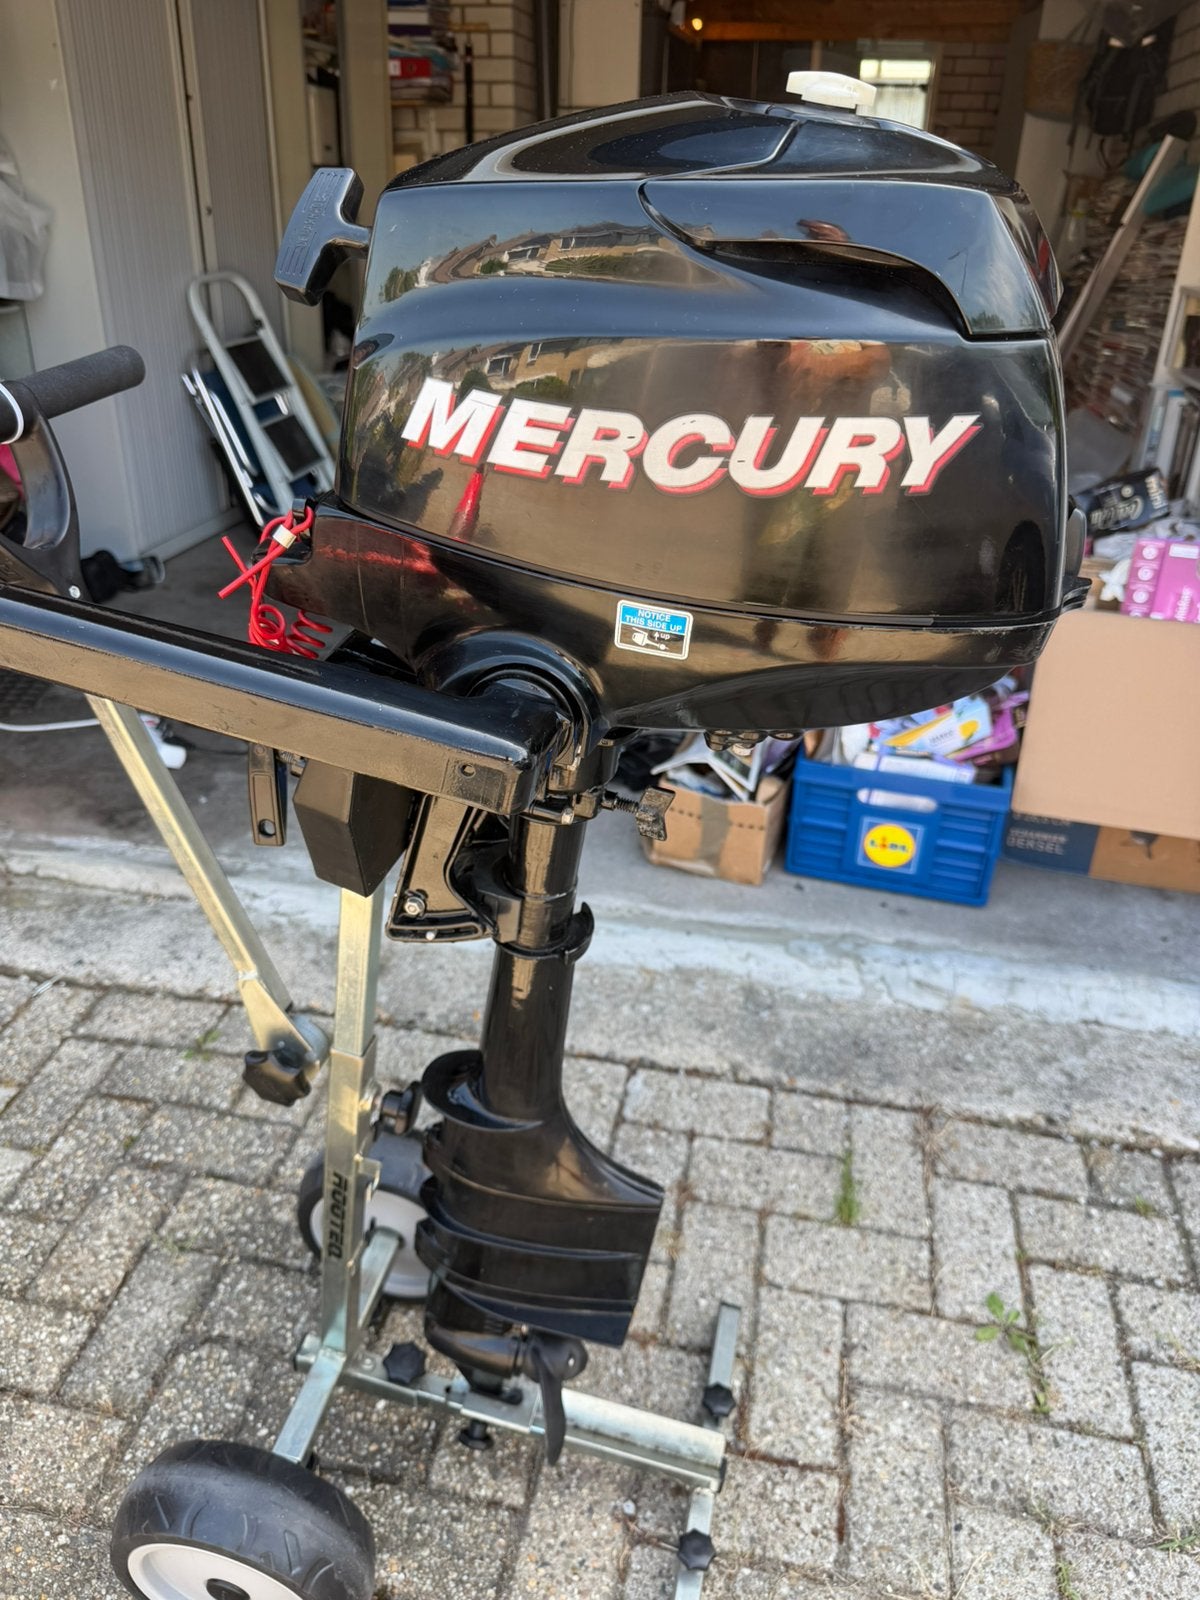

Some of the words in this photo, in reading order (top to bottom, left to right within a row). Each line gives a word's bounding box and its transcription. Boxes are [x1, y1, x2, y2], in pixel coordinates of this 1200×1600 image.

[401, 377, 984, 498] MERCURY
[625, 615, 645, 626] THIS
[647, 620, 667, 630] SIDE
[669, 624, 683, 632] UP
[638, 609, 671, 622] NOTICE
